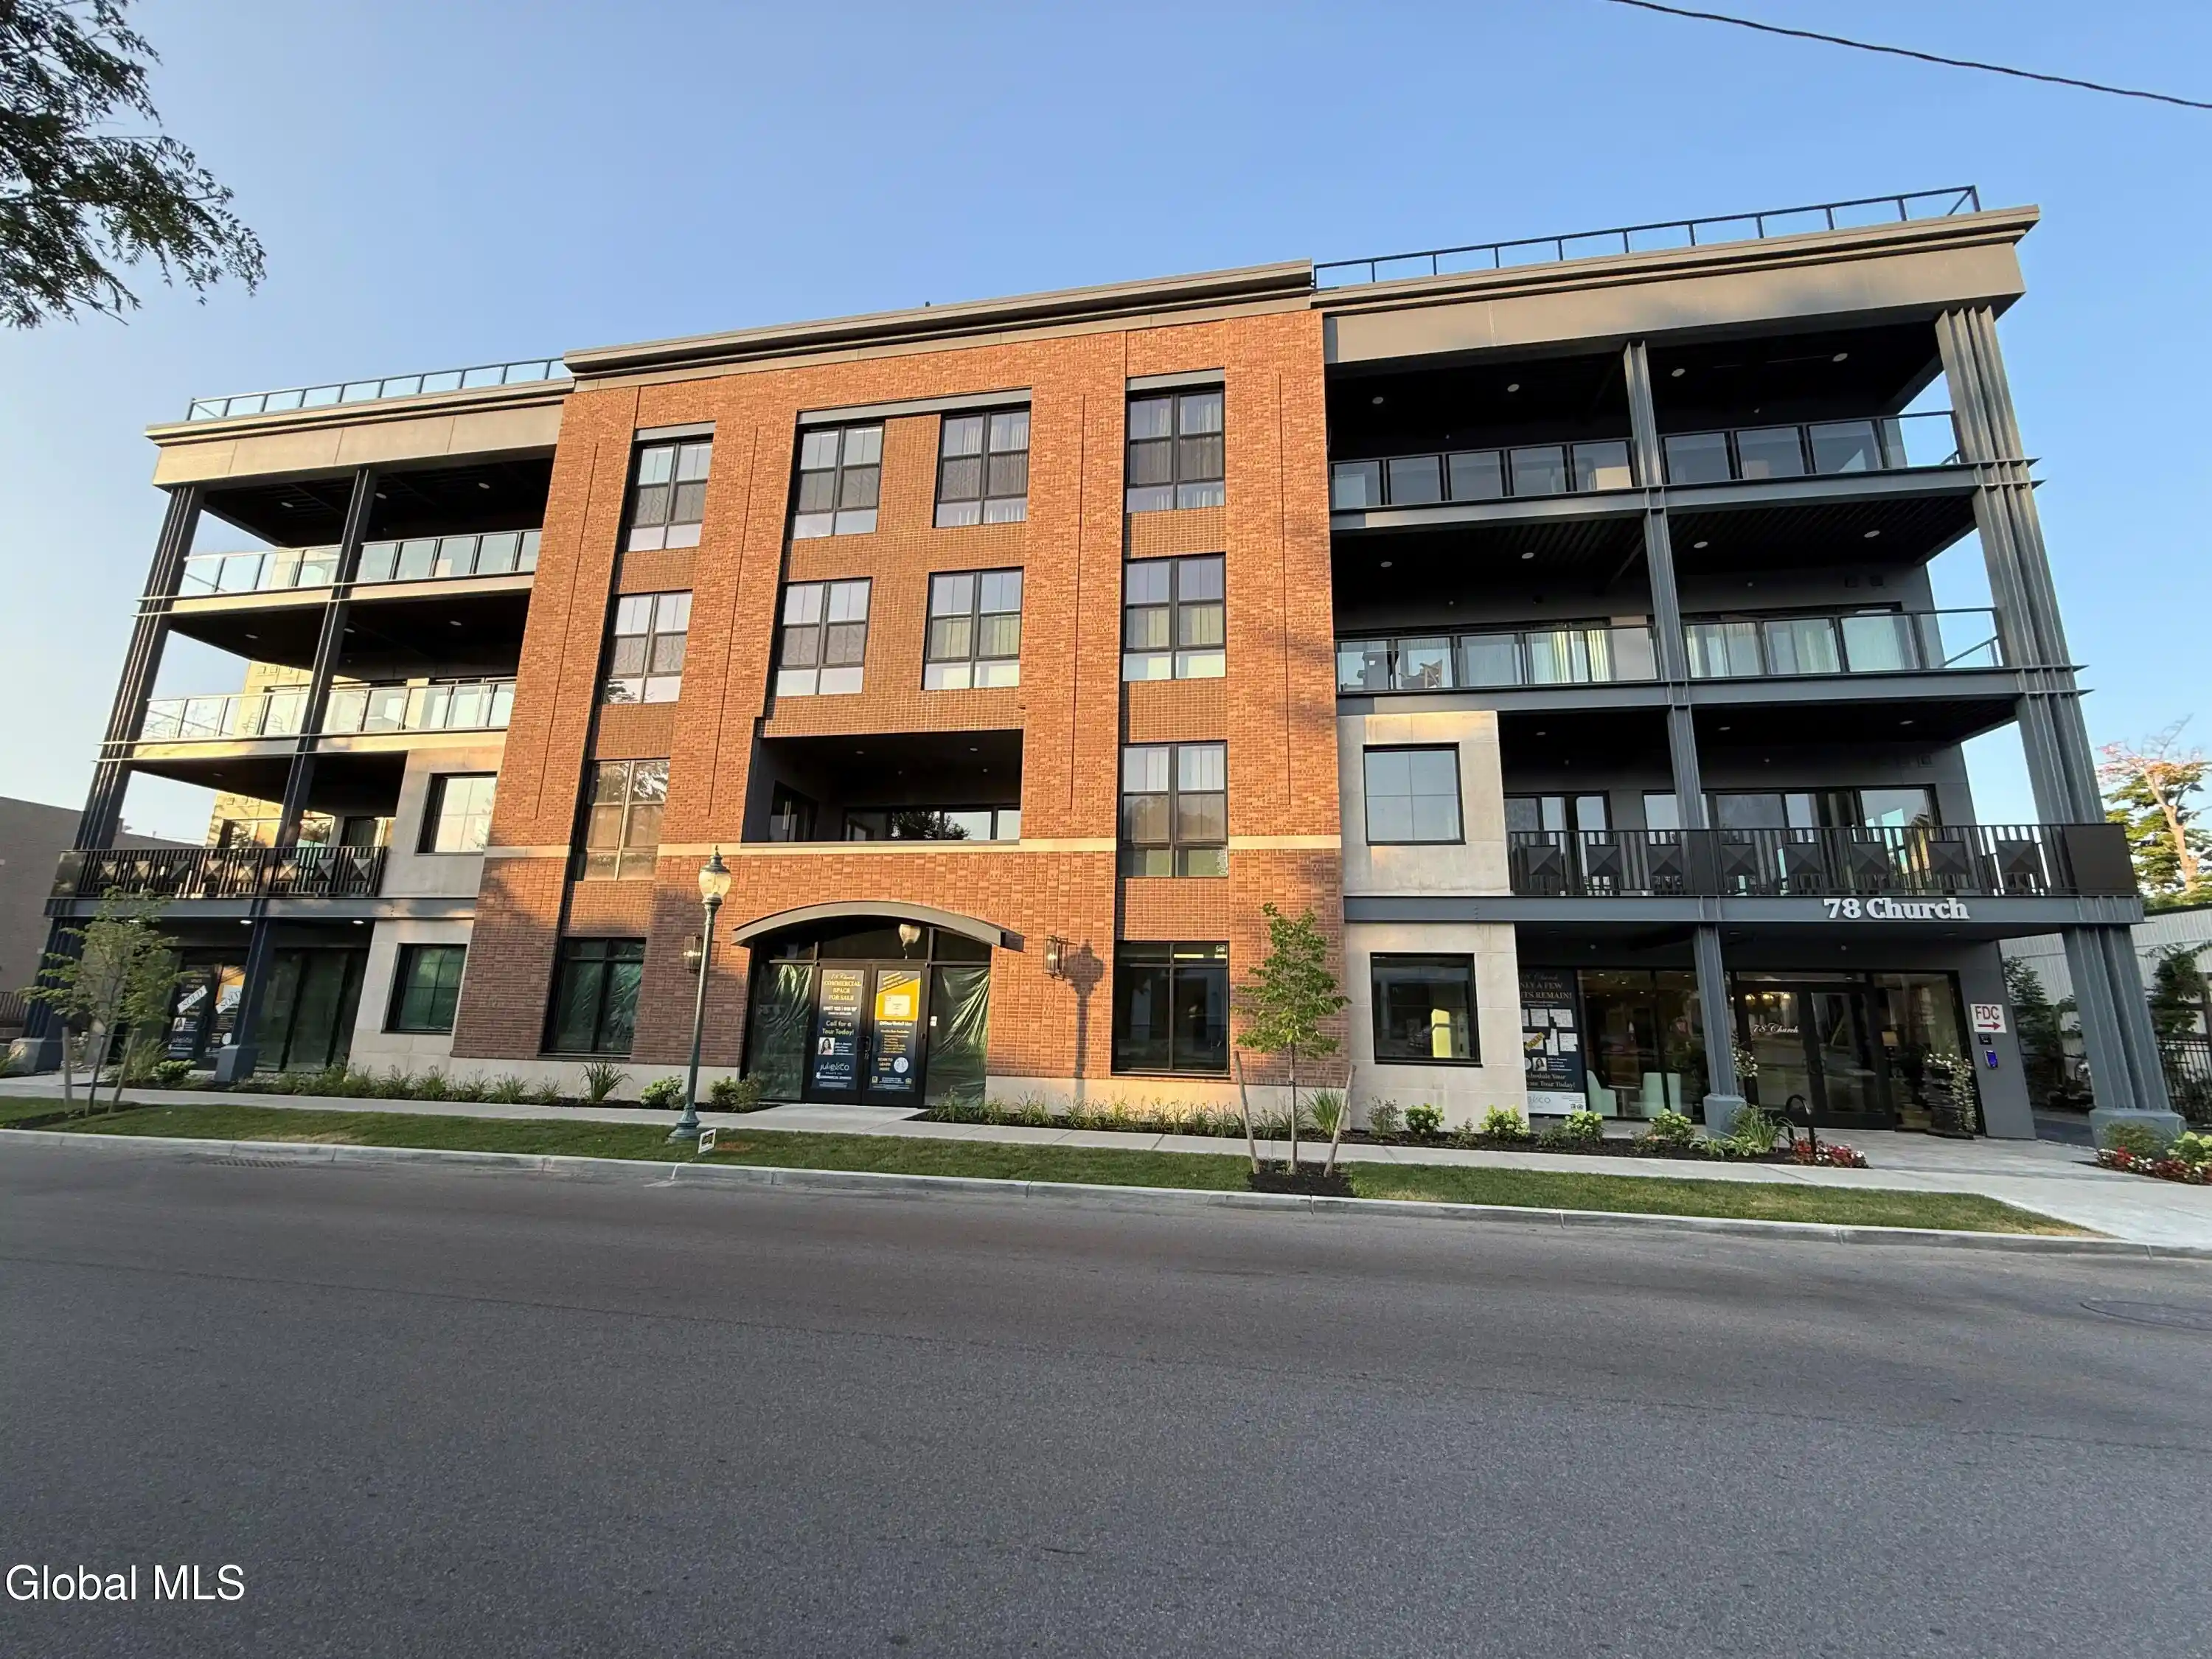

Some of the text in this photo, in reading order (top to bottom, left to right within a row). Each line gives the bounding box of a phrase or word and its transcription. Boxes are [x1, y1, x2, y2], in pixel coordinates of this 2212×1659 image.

[1823, 897, 1971, 919] 78 Church
[1520, 981, 1535, 990] NLY
[182, 990, 203, 1009] SOLD
[1975, 1006, 2000, 1020] FDC
[1753, 1023, 1798, 1034] 78 Church
